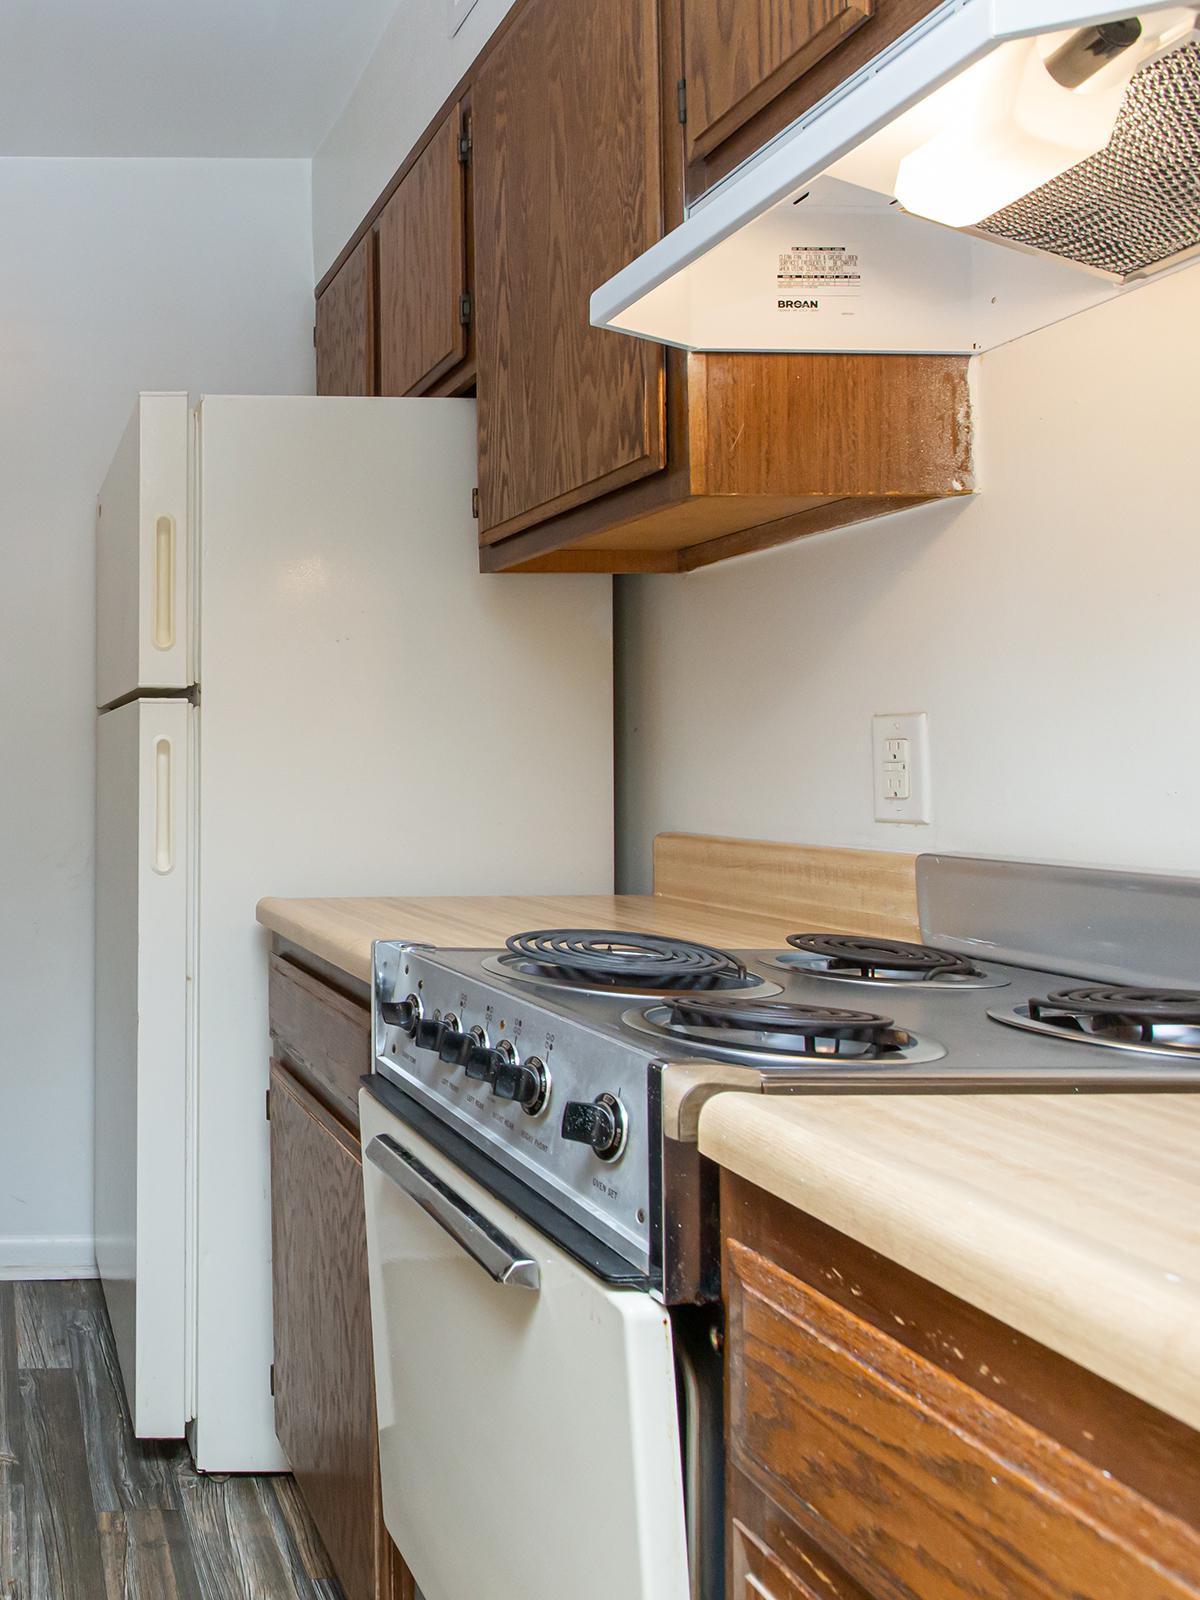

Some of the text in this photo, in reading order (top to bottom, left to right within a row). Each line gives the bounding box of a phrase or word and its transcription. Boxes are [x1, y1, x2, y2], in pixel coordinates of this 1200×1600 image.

[777, 300, 818, 308] BROAN
[593, 1178, 618, 1200] OVEN SET
